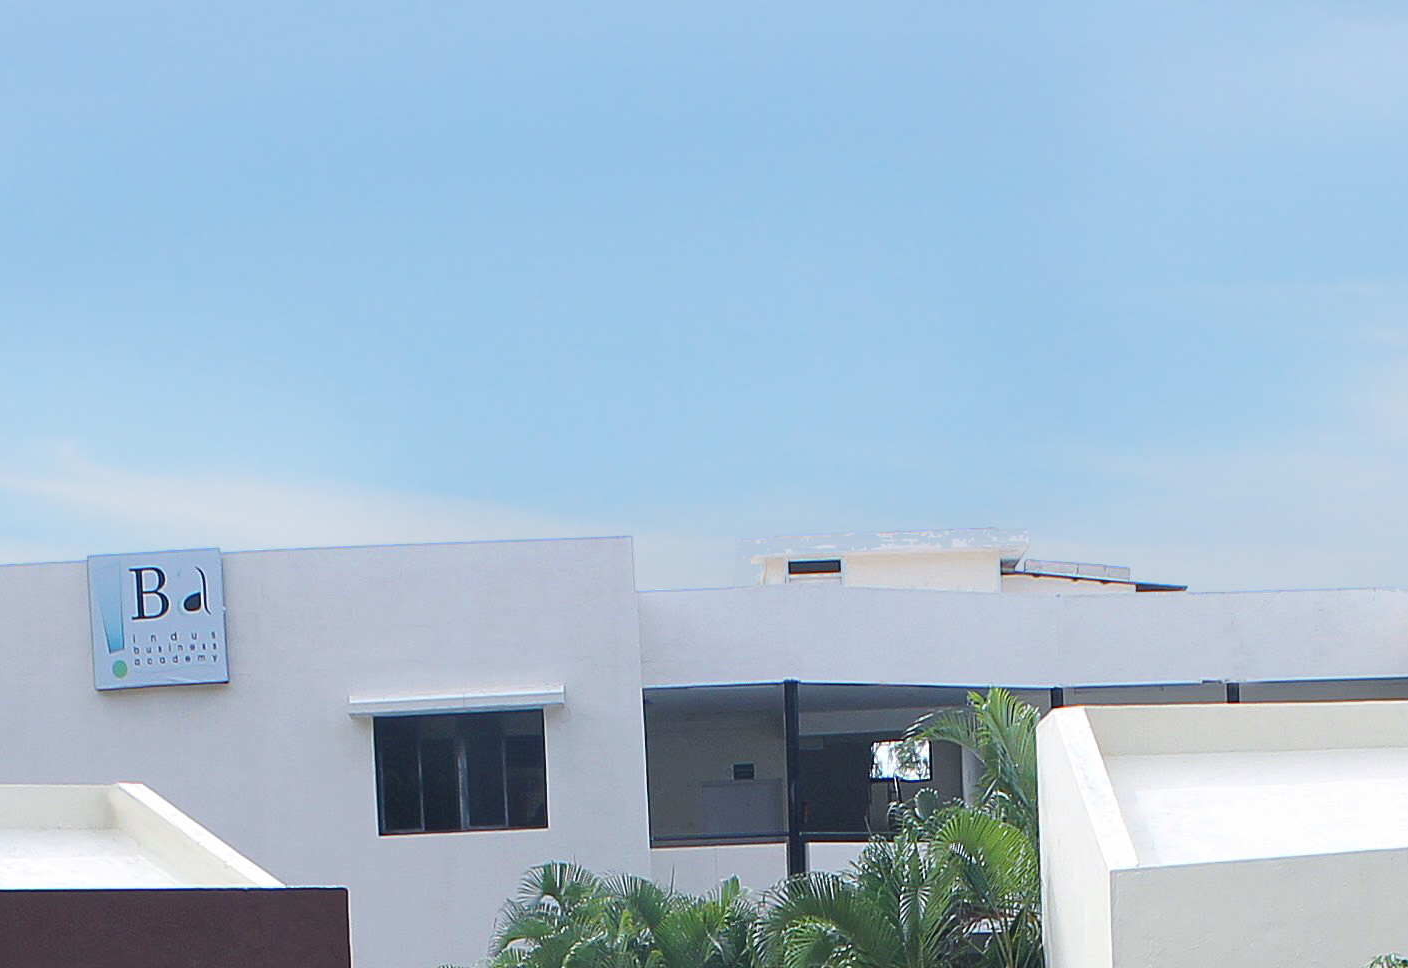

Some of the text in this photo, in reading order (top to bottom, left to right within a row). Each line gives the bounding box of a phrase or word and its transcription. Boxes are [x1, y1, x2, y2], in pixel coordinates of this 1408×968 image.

[132, 631, 217, 643] indus
[133, 643, 217, 655] business
[134, 655, 218, 666] academy
